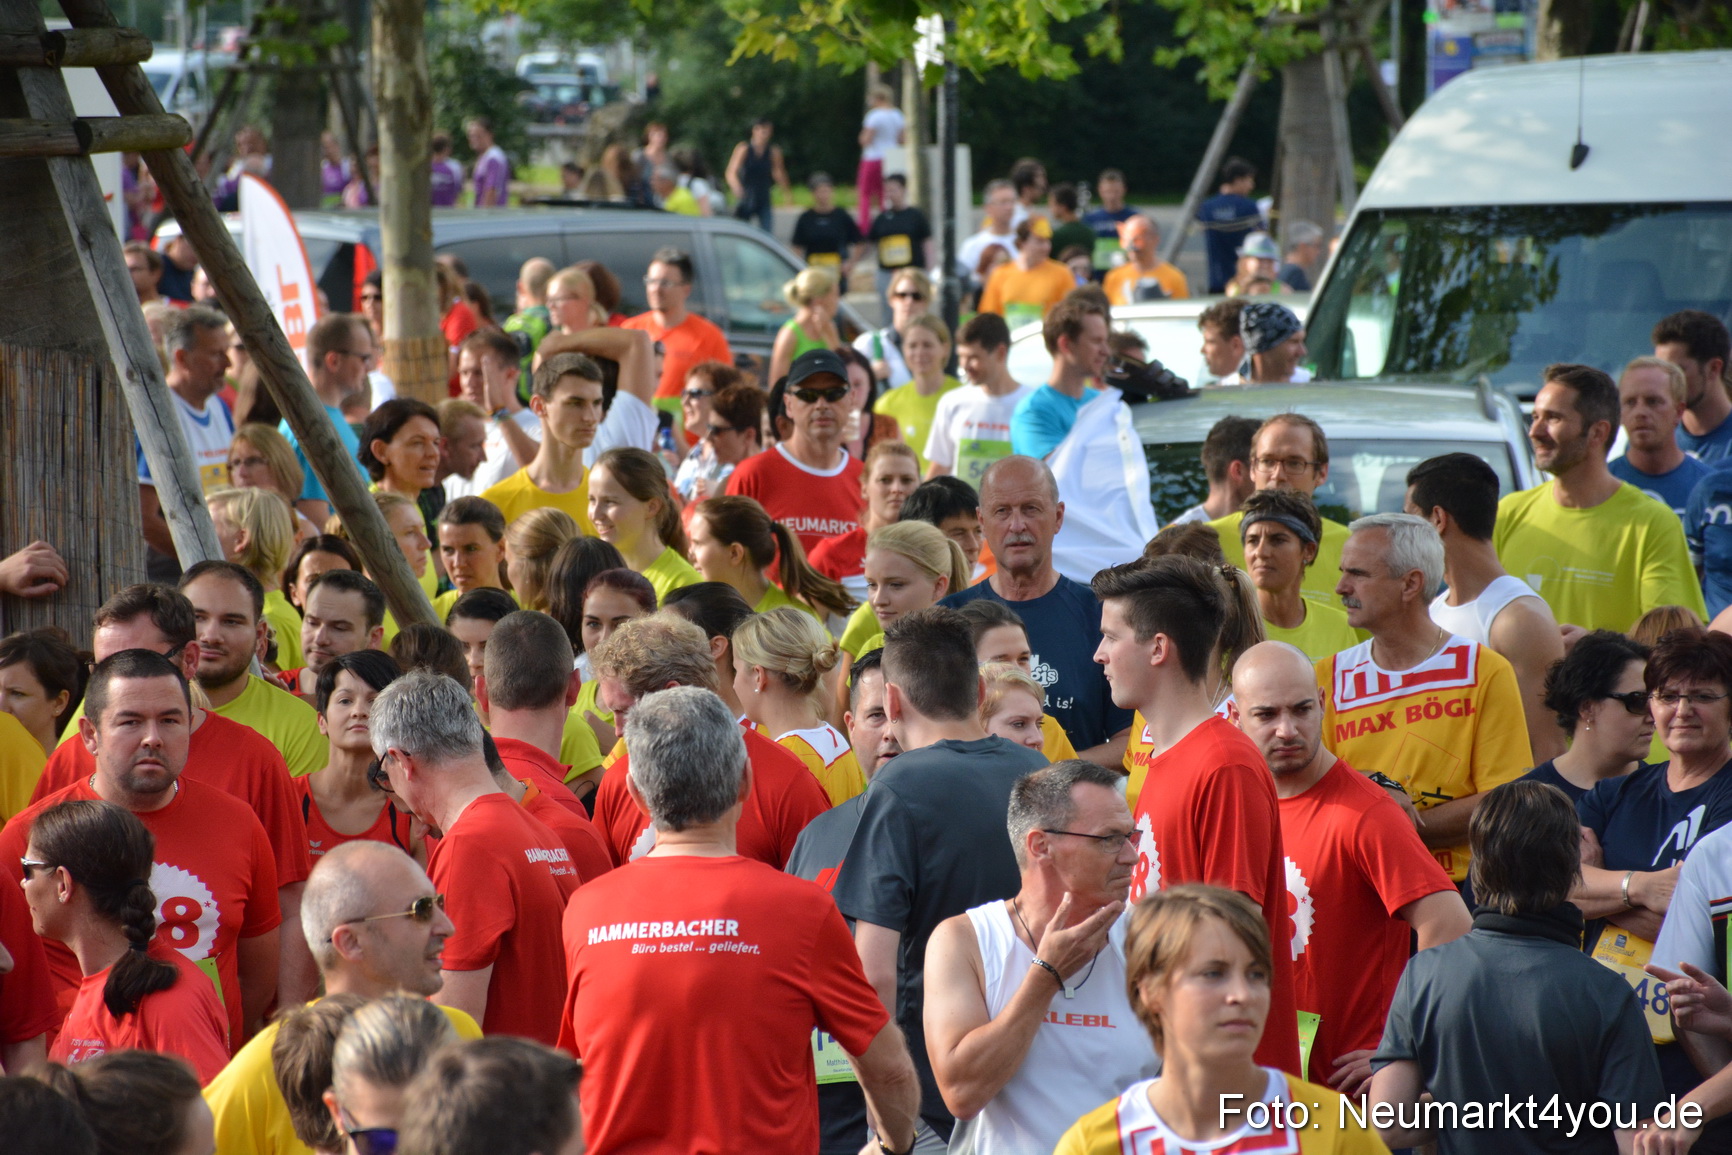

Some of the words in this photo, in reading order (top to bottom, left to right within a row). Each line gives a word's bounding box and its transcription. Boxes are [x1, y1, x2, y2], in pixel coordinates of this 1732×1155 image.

[1056, 697, 1073, 710] is!
[1335, 711, 1397, 743] MAX
[1405, 696, 1476, 724] BÖGL
[588, 919, 739, 945] HAMMERBACHER
[631, 943, 656, 954] Büro
[659, 942, 693, 953] bestel
[709, 941, 760, 955] geliefert.
[1620, 973, 1670, 1015] 48
